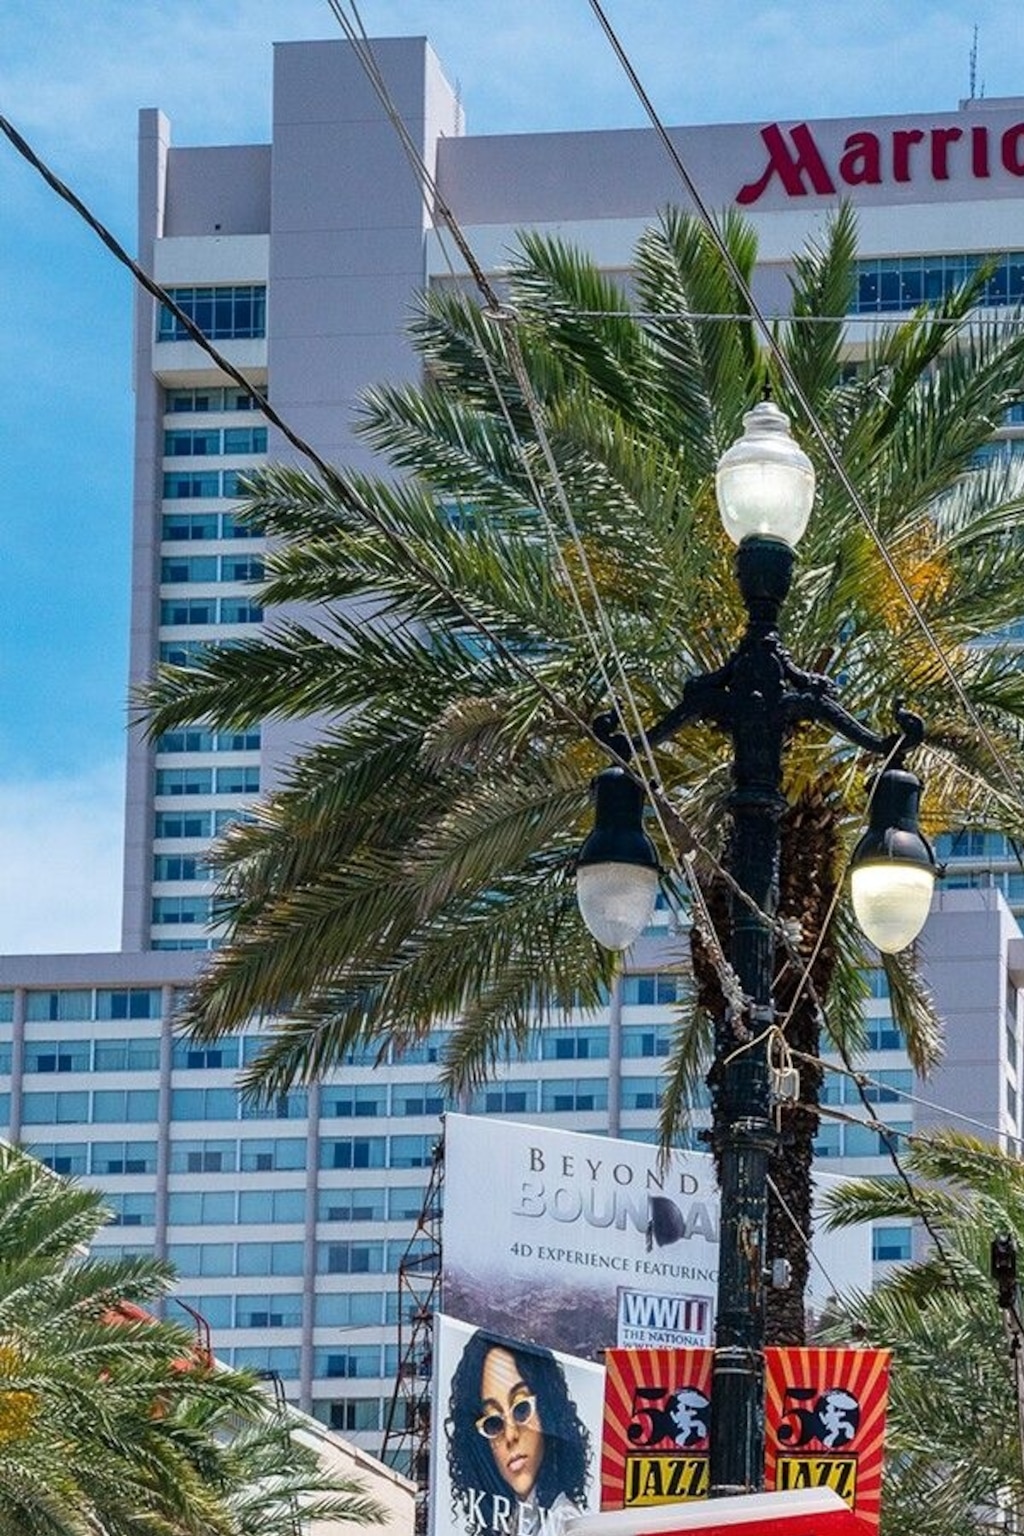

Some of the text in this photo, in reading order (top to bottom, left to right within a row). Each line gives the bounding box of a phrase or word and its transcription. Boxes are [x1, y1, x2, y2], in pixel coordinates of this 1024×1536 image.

[530, 1147, 699, 1196] BEYOND
[512, 1180, 720, 1248] BOUNDA
[510, 1242, 533, 1258] 4D
[538, 1246, 630, 1272] EXPERIENCE
[624, 1293, 704, 1332] WWII
[623, 1329, 646, 1341] THE
[648, 1332, 706, 1347] NATIONAL
[627, 1458, 709, 1505] JAZZ
[779, 1460, 854, 1500] JAZZ
